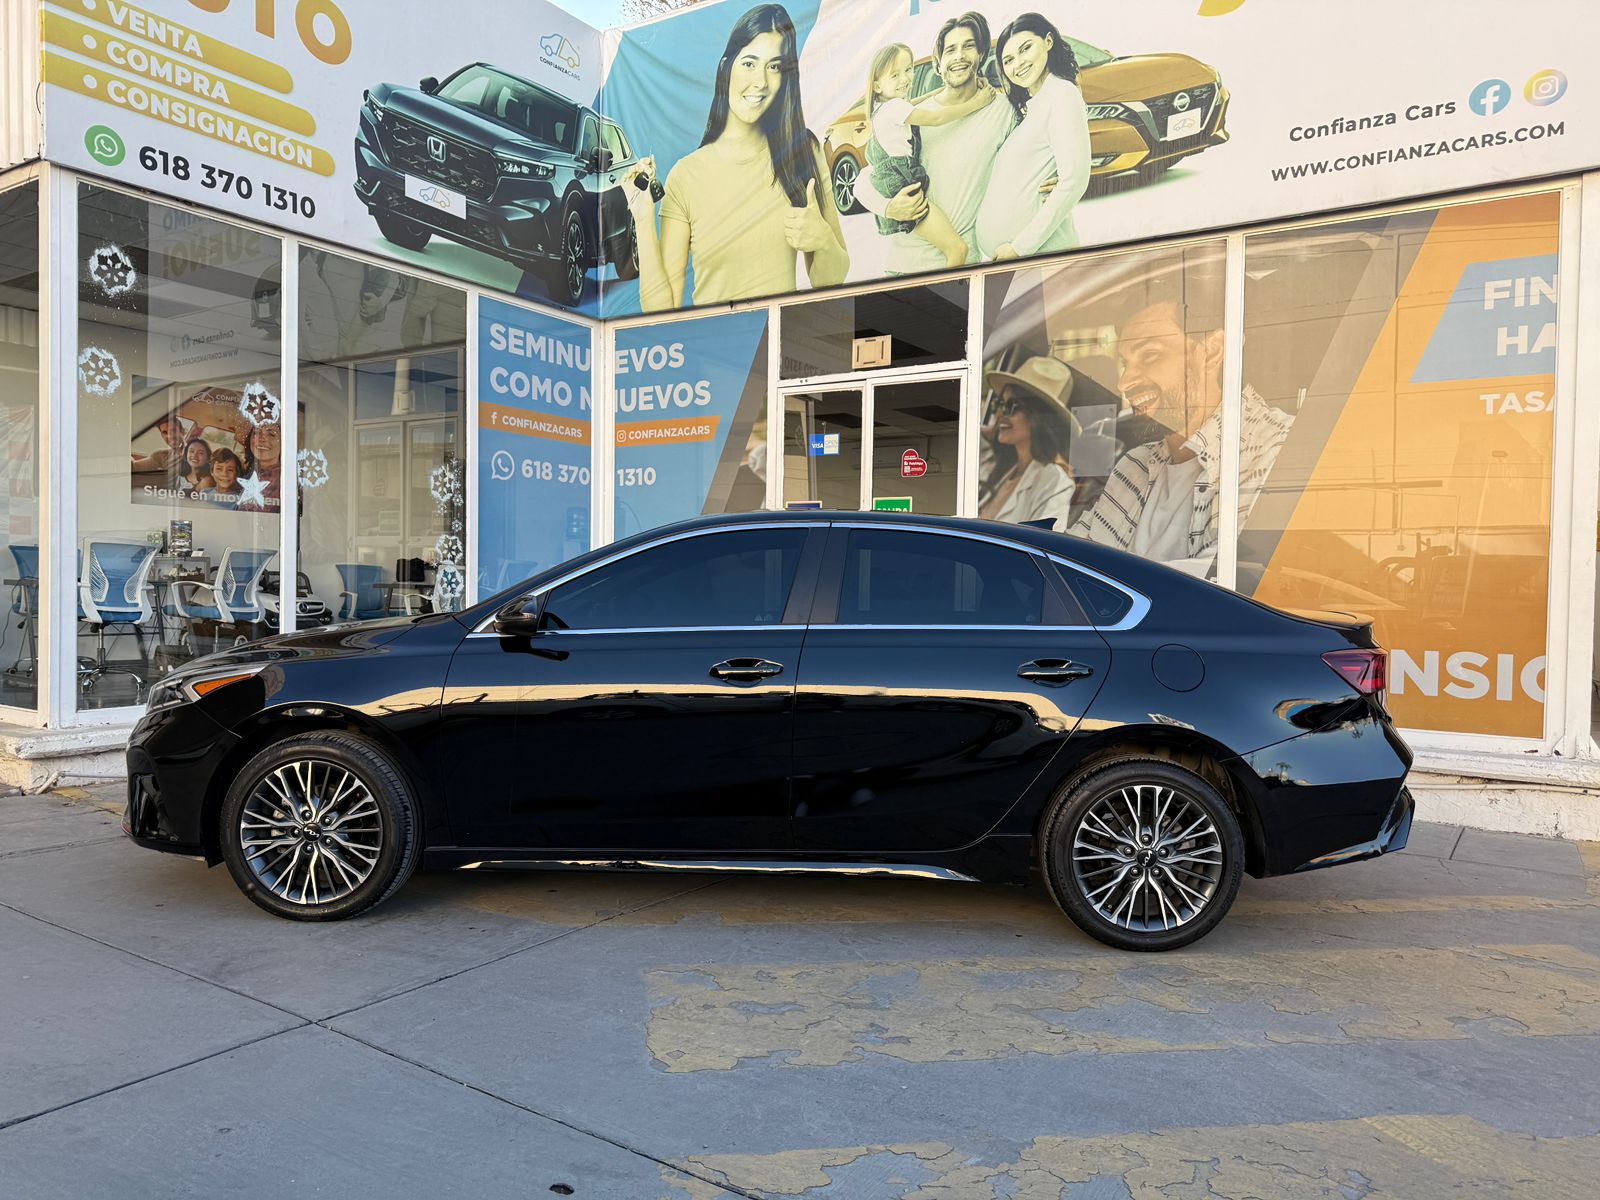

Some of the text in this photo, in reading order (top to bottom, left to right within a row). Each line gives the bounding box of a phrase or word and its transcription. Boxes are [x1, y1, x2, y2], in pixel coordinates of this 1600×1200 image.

[106, 1, 203, 58] VENTA
[106, 41, 230, 104] COMPRA
[107, 80, 313, 168] CONSIGNACIÓN
[1289, 101, 1456, 142] Confianza Cars
[1271, 121, 1565, 181] WWW.CONFIANZACARS.COM
[139, 146, 315, 218] 618 370 1310
[1484, 274, 1557, 310] FIN
[489, 366, 572, 407] COMO
[502, 415, 583, 438] CONFIANZACARS
[628, 425, 710, 441] CONFIANZACARS
[143, 485, 186, 500] Sigue
[190, 491, 208, 501] en
[521, 458, 656, 487] 618 370 1310
